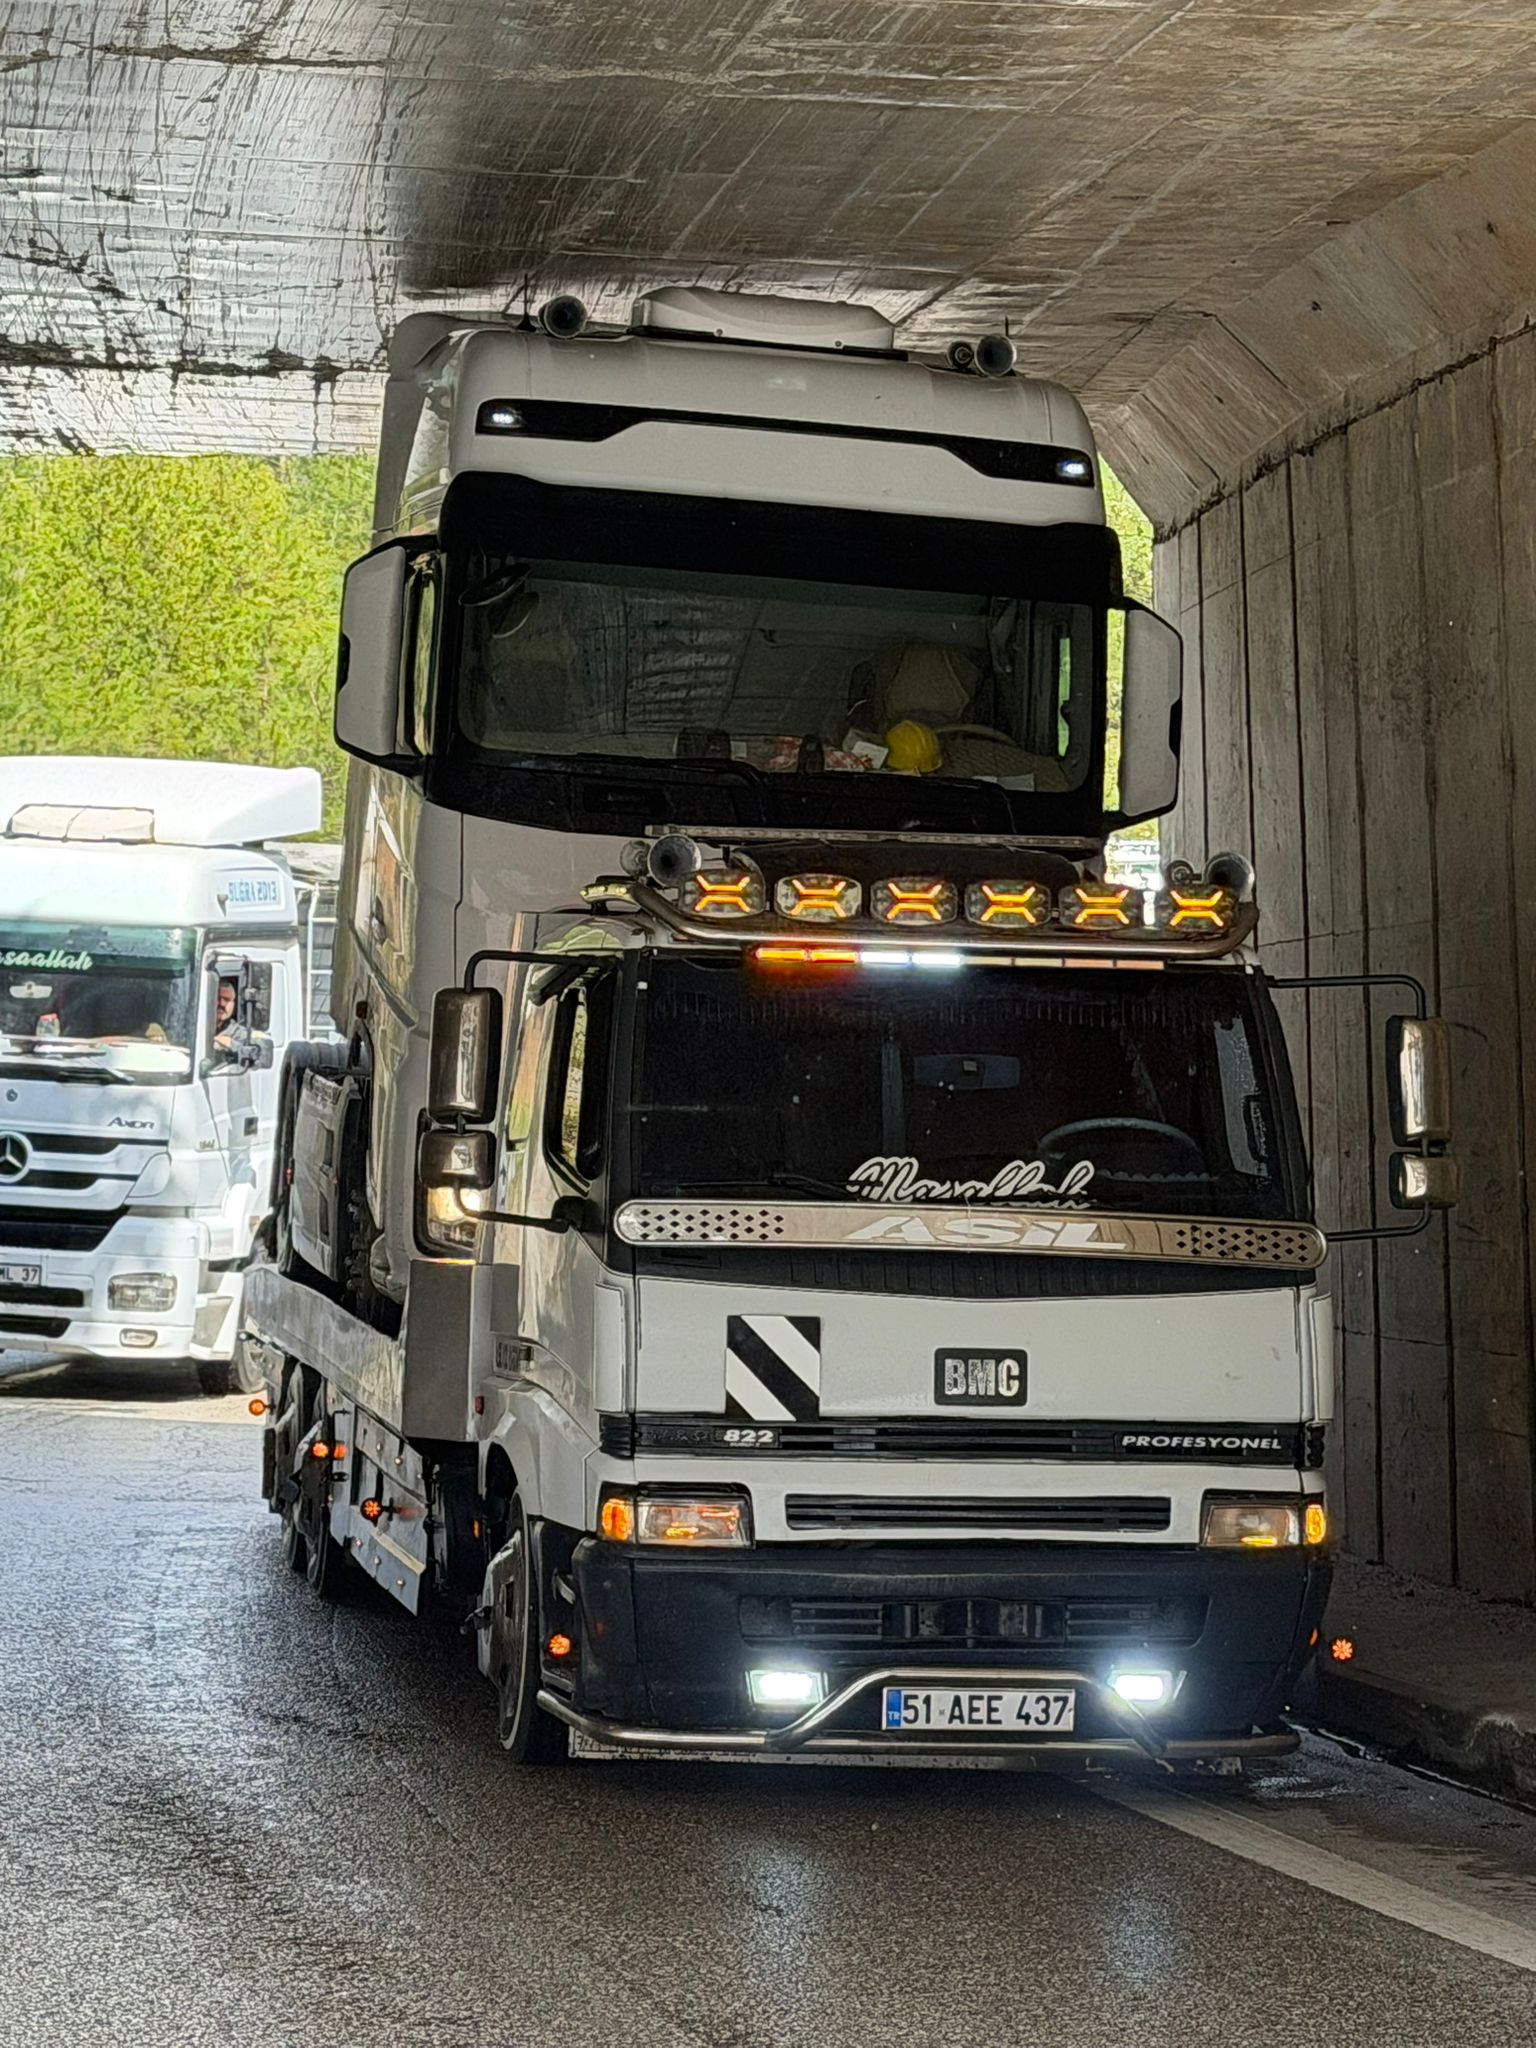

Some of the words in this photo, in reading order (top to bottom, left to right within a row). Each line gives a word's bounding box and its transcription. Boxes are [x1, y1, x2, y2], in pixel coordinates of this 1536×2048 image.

[22, 1267, 38, 1282] 37
[944, 1358, 1020, 1397] BMC
[723, 1429, 774, 1442] 822
[1122, 1435, 1282, 1449] PROFESYONEL
[902, 1694, 932, 1725] 51
[948, 1694, 1004, 1725] AEE
[1015, 1695, 1070, 1726] 437
